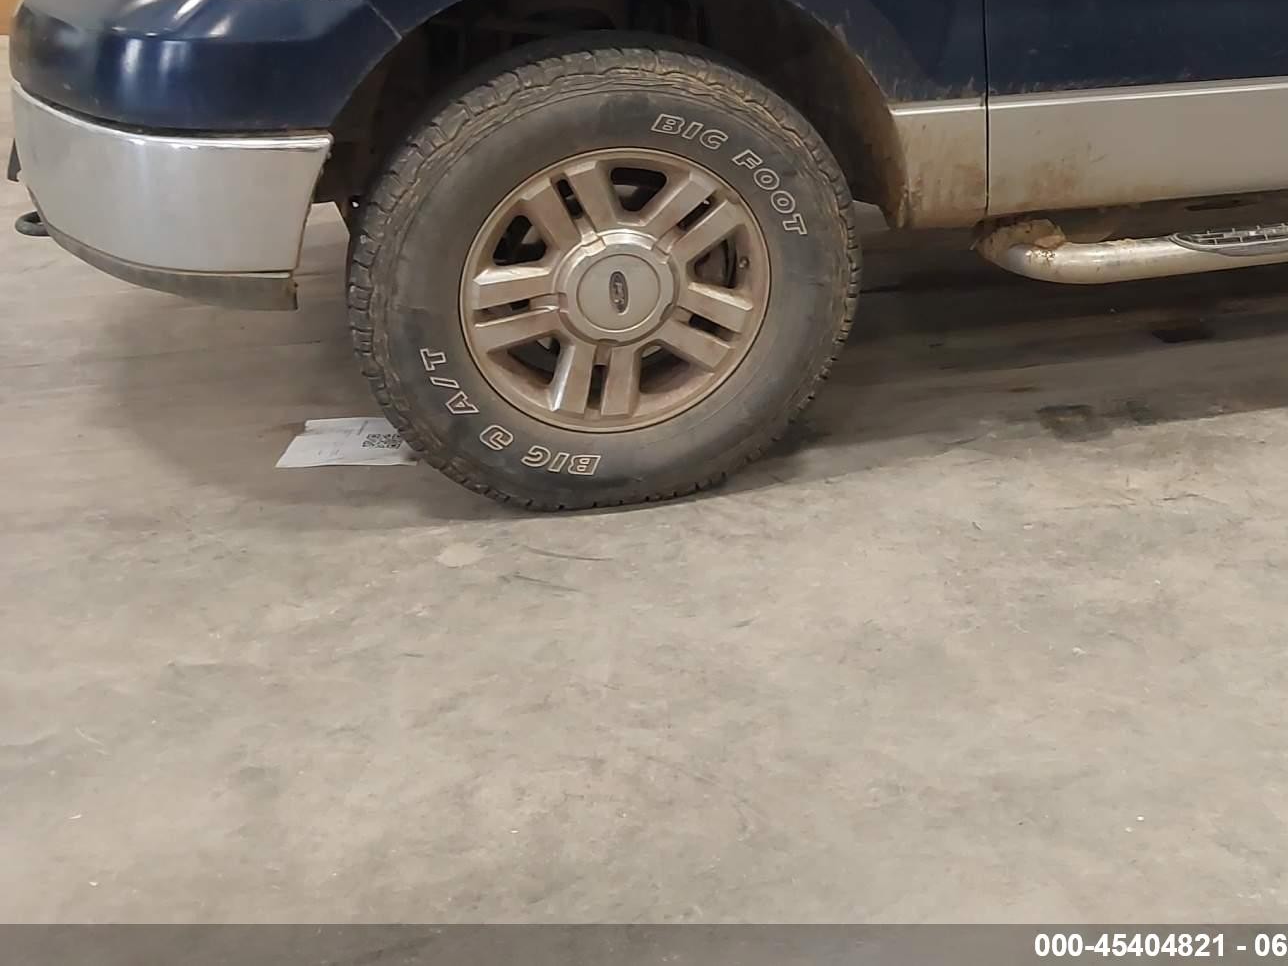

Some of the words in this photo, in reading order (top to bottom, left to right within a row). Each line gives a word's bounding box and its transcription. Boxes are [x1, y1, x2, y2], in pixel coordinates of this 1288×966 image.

[651, 113, 729, 150] BIG
[731, 149, 808, 236] FOOT
[420, 348, 480, 415] A/T
[520, 445, 600, 476] BIG
